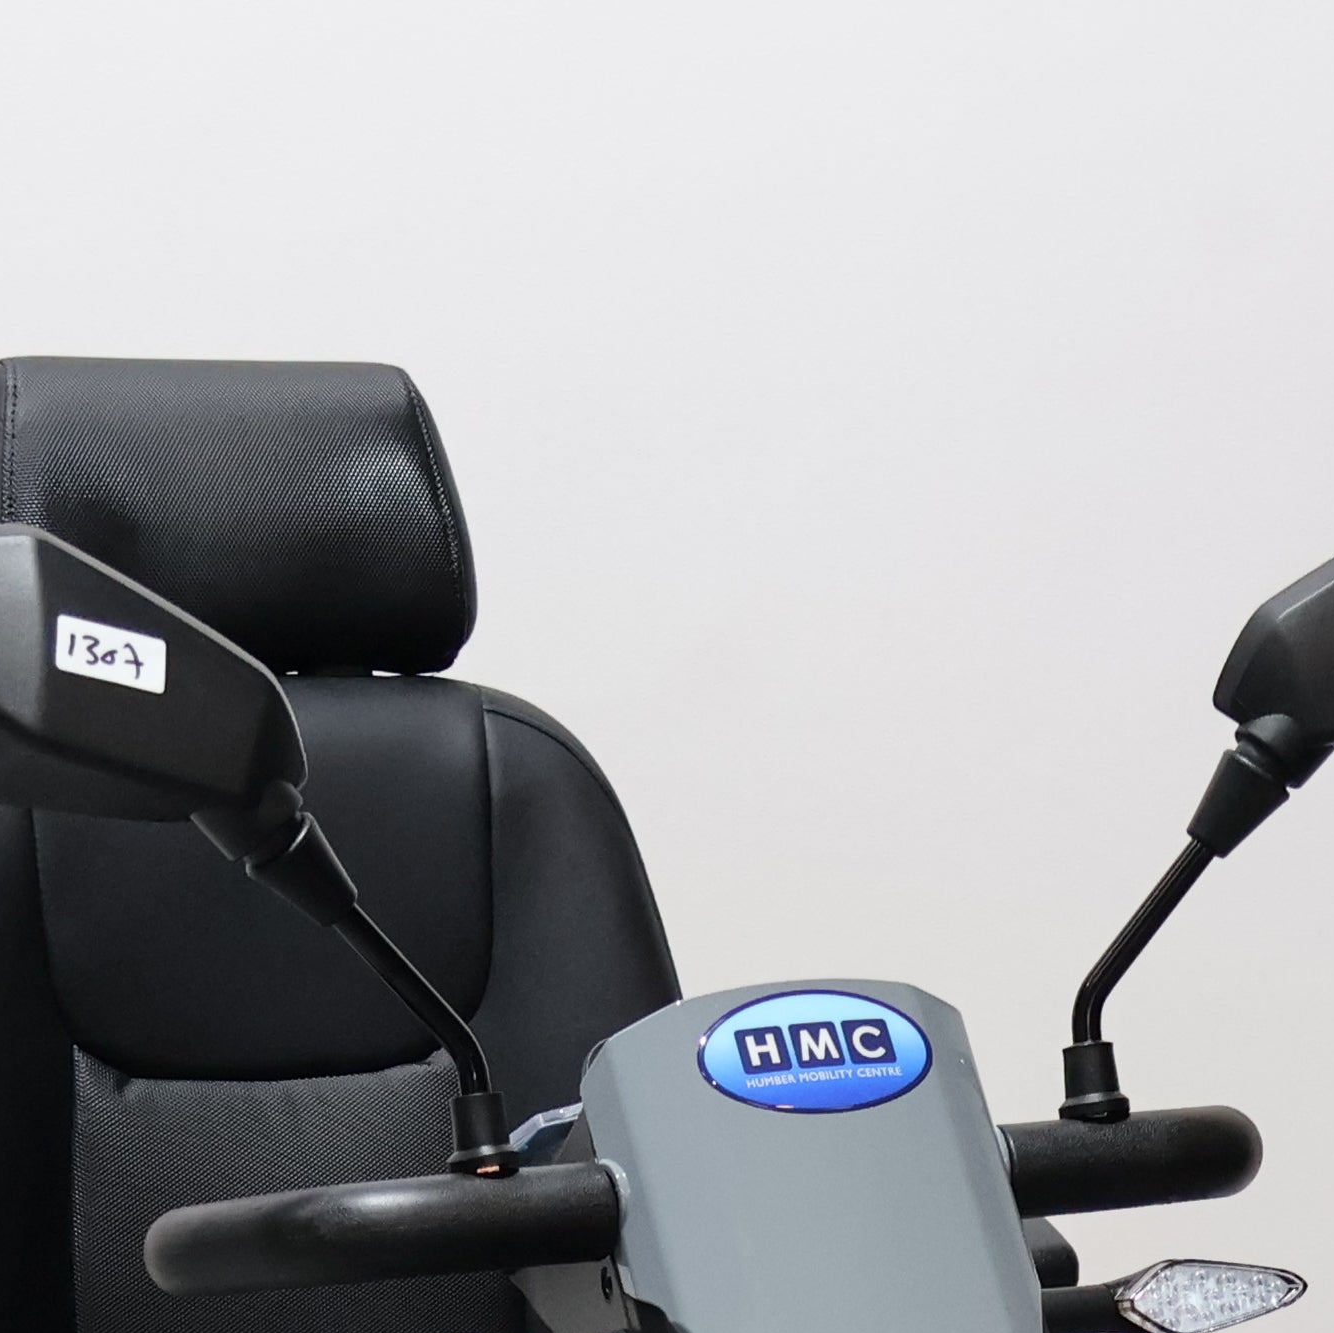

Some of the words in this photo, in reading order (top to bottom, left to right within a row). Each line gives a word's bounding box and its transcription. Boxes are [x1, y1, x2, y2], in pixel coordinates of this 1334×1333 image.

[68, 633, 144, 680] 1307
[744, 1025, 886, 1067] HMC
[746, 1075, 797, 1089] HUMBER
[799, 1069, 853, 1082] MOBILITY
[857, 1066, 903, 1077] CENTRE
